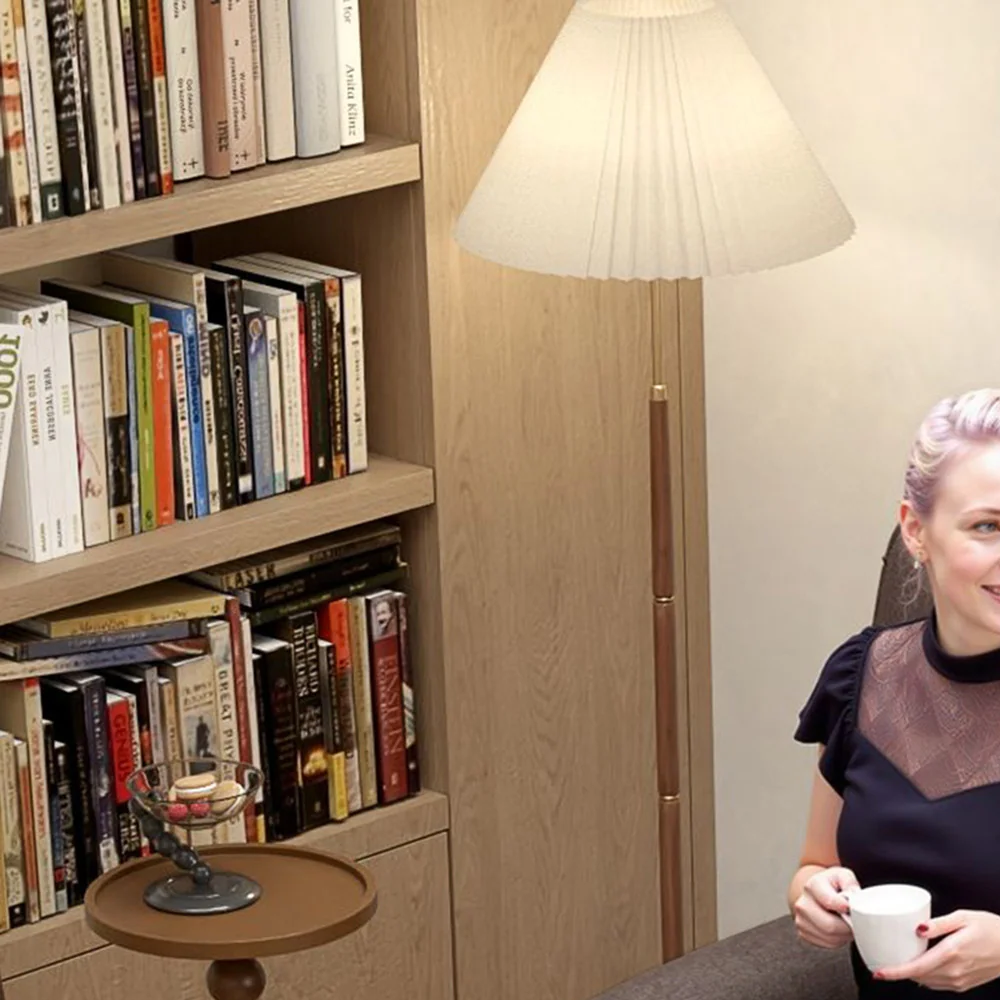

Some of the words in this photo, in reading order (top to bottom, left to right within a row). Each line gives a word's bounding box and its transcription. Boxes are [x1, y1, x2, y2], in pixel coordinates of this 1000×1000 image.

[345, 64, 356, 99] Anita
[347, 102, 358, 136] Klinz
[218, 669, 231, 721] GREAT
[112, 712, 132, 784] GENIUS
